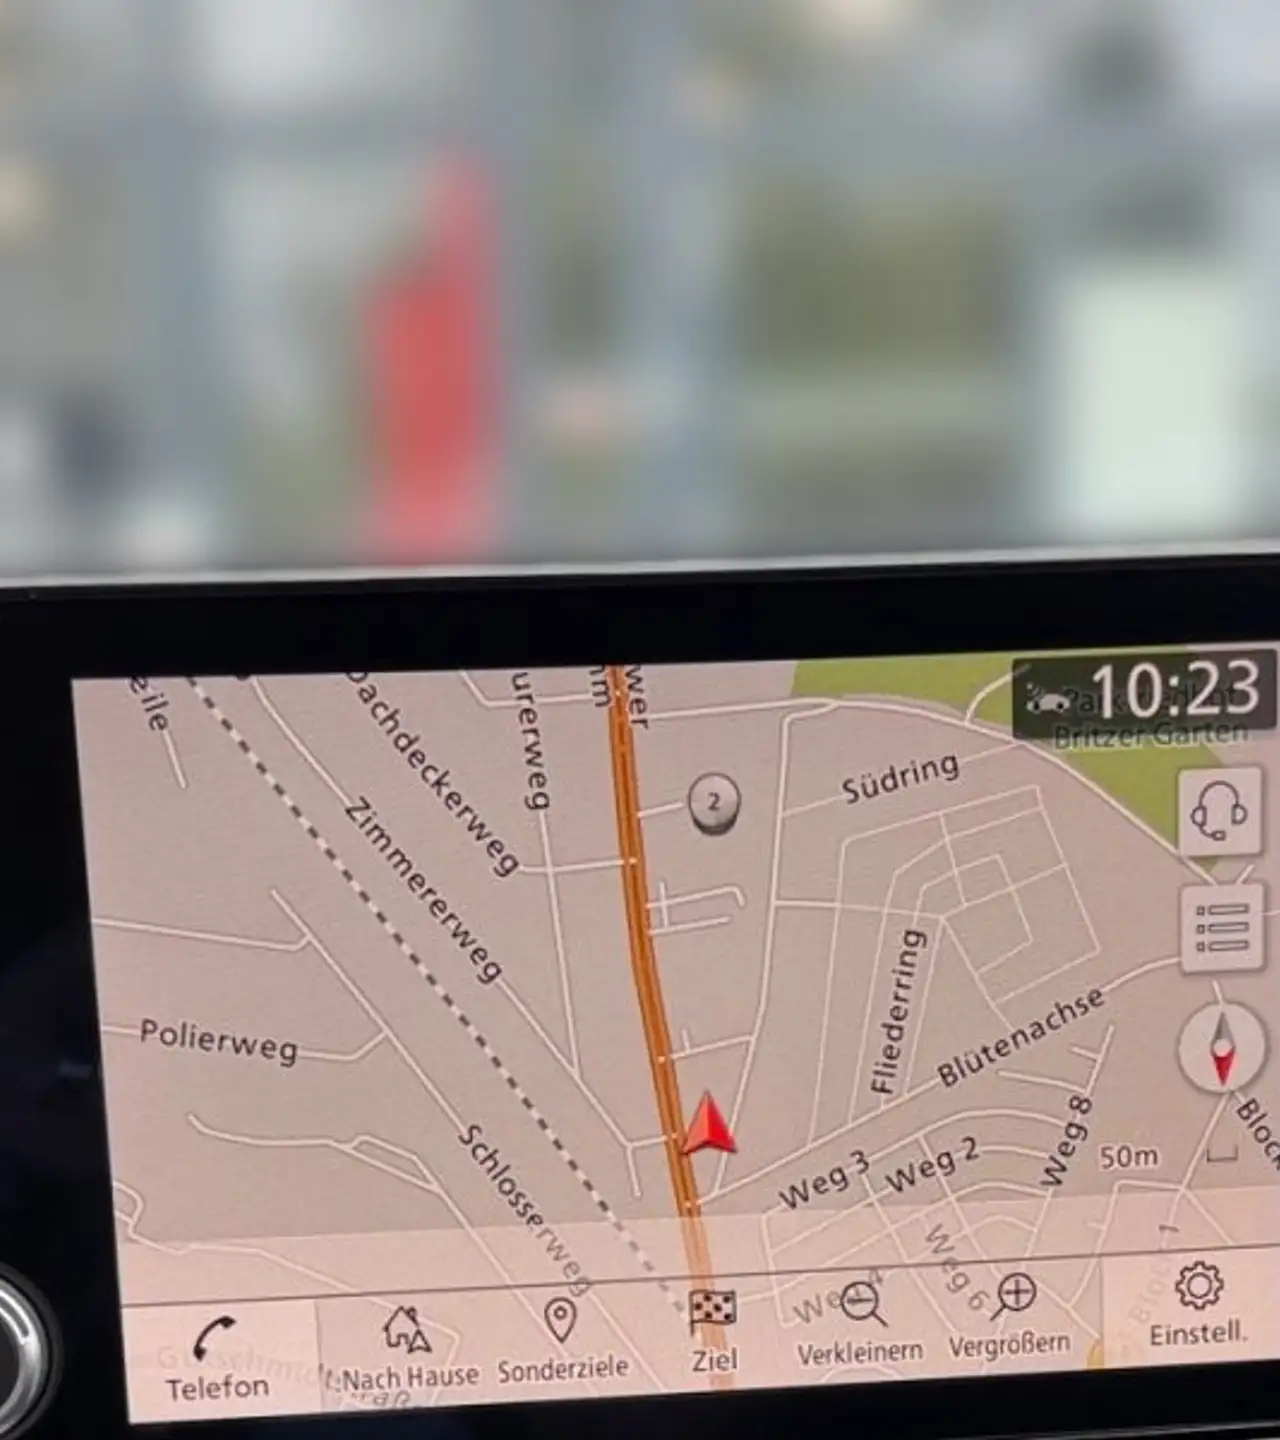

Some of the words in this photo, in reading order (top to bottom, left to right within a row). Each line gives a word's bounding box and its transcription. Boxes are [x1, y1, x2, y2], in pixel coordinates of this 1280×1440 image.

[1093, 658, 1260, 719] 10:23
[511, 671, 550, 811] urerweg
[1055, 722, 1144, 750] Britzer
[1154, 718, 1250, 747] Garten
[707, 791, 721, 812] 2
[842, 752, 960, 805] Südring
[345, 796, 503, 985] Zimmererweg
[872, 928, 928, 1096] Fliederring
[936, 986, 1106, 1089] Blütenachse
[140, 1018, 298, 1068] Polierweg
[886, 1152, 953, 1194] Weg
[961, 1137, 980, 1160] 2
[1041, 1125, 1088, 1190] Weg
[1074, 1094, 1093, 1116] 8
[1100, 1146, 1159, 1169] 50m
[780, 1166, 845, 1211] Weg
[850, 1150, 872, 1174] 3
[459, 1124, 592, 1298] Schlosserweg
[925, 1223, 970, 1294] Weg
[798, 1340, 923, 1366] Verkleinern
[949, 1331, 1071, 1362] Vergrößern
[1150, 1318, 1249, 1346] Einstell.
[343, 1365, 402, 1391] Nach
[408, 1364, 480, 1389] Hause
[498, 1355, 630, 1384] Sonderziele
[692, 1348, 738, 1372] Ziel
[166, 1375, 270, 1401] Telefon
